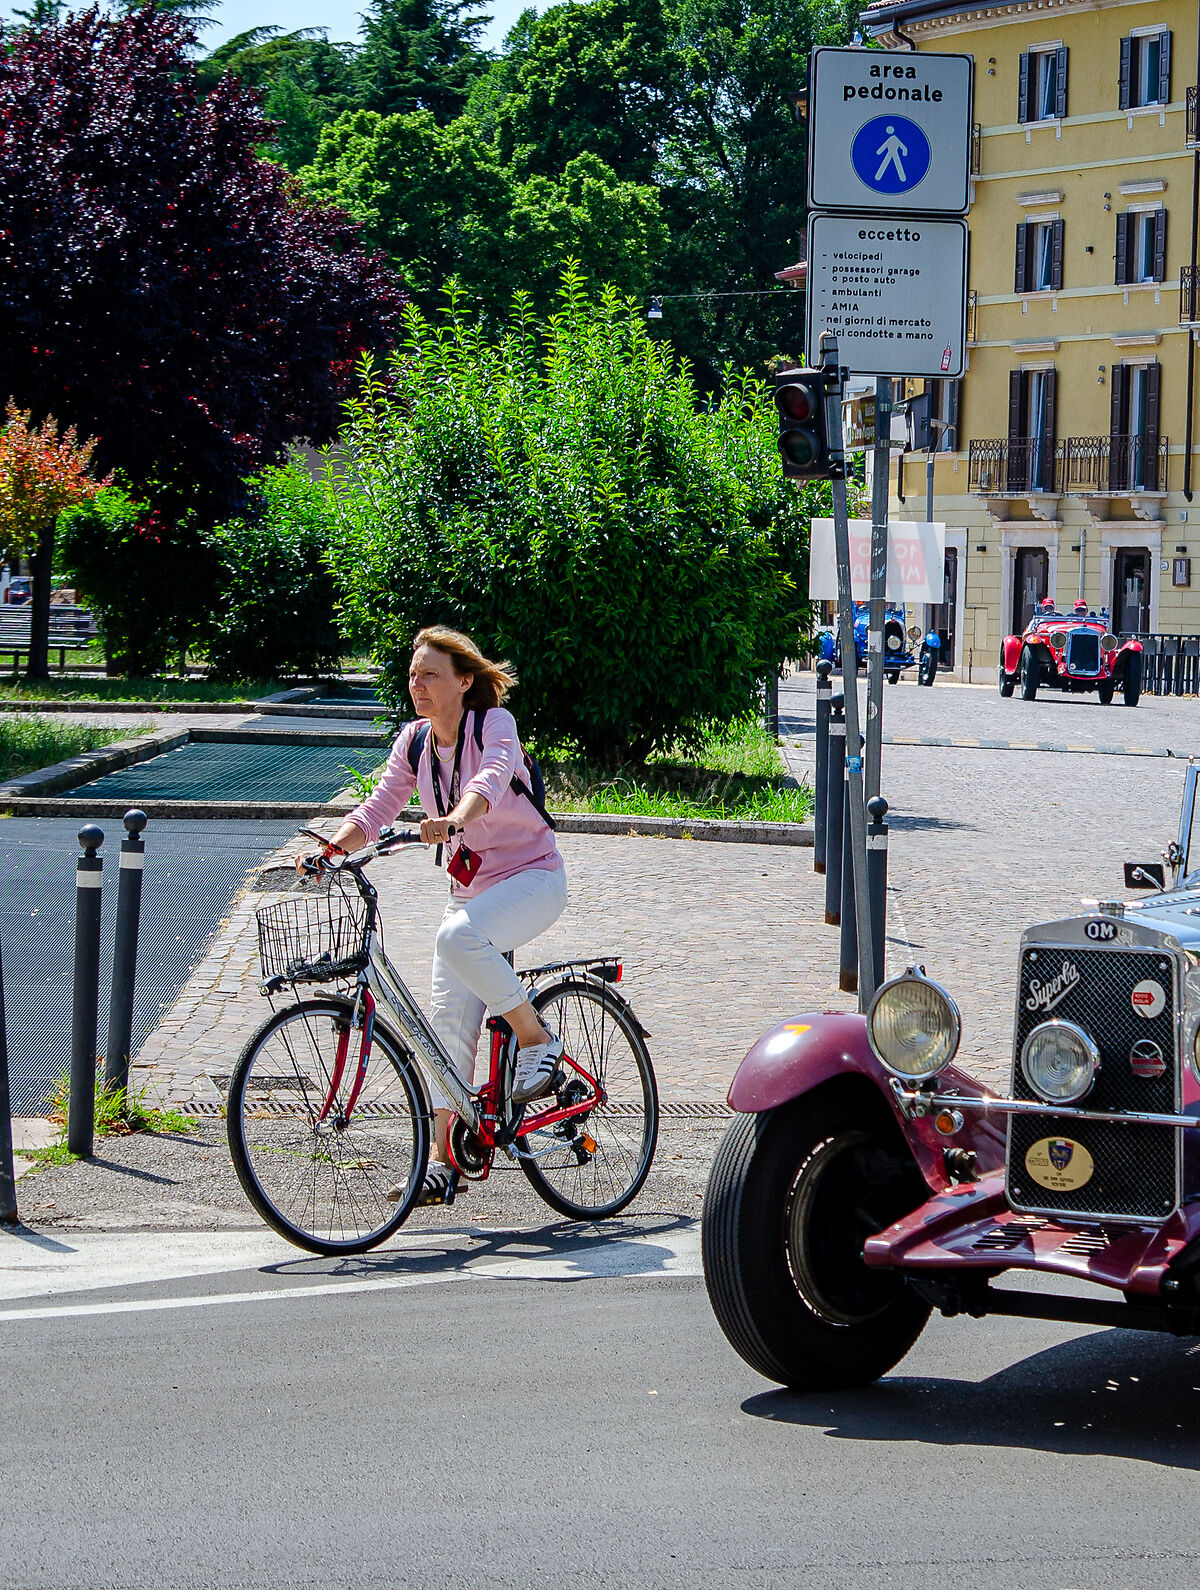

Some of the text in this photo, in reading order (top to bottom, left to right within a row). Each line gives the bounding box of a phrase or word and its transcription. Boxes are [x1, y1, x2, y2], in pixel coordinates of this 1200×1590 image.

[869, 64, 917, 80] area
[843, 82, 943, 103] pedonale
[857, 227, 921, 242] eccetto
[833, 251, 883, 262] velocipedi
[832, 265, 920, 277] possessori garage
[831, 275, 896, 285] o posto auto
[831, 287, 882, 297] ambulanti
[831, 302, 859, 312] AMIA
[826, 315, 932, 327] nei giorni di mercato
[847, 328, 894, 339] condotte
[896, 331, 903, 339] a
[905, 332, 934, 341] mano
[1087, 922, 1114, 939] OM
[1026, 961, 1080, 1011] Superba
